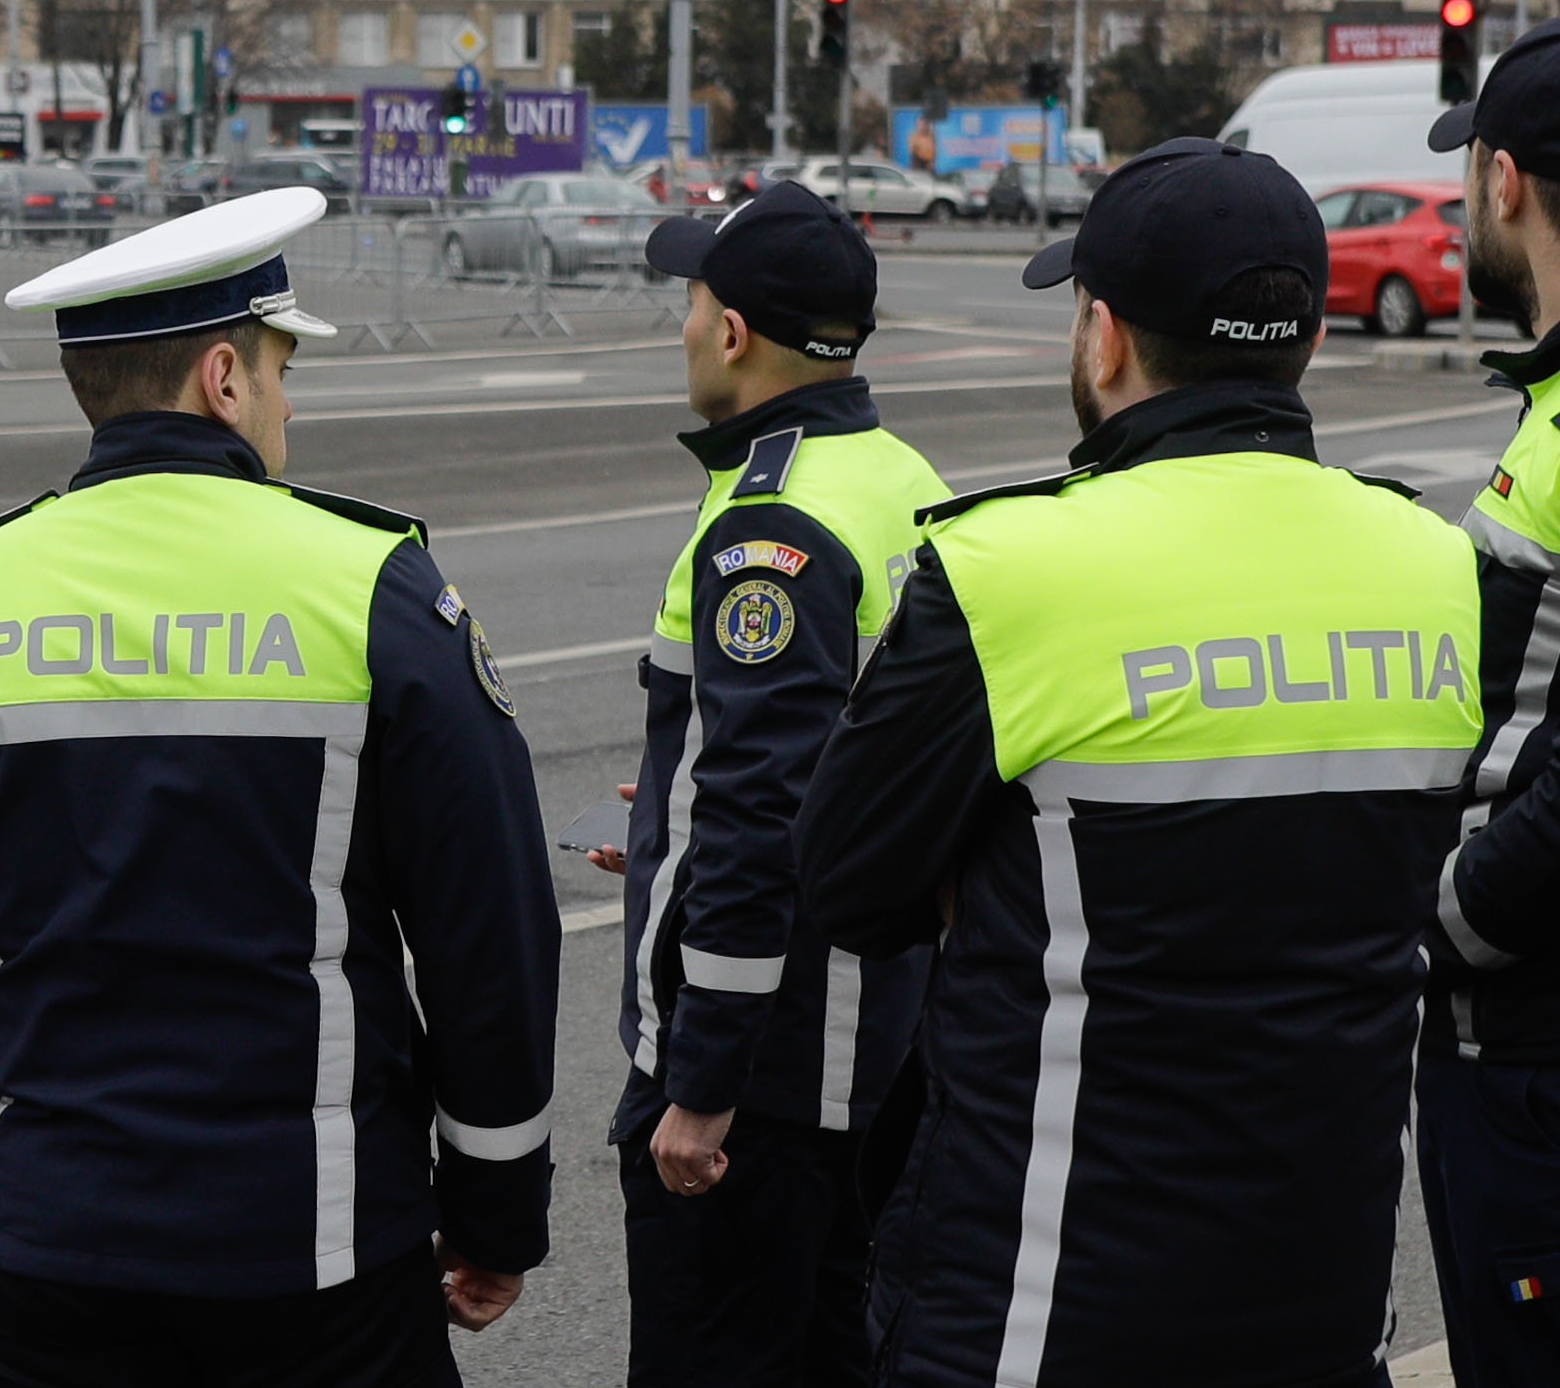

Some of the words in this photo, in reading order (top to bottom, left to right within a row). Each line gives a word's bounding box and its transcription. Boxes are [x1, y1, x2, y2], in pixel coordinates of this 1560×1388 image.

[1210, 317, 1298, 341] POLITIA
[805, 341, 852, 357] POLITIA
[718, 546, 799, 572] ROMANIA
[1121, 630, 1465, 720] POLITIA
